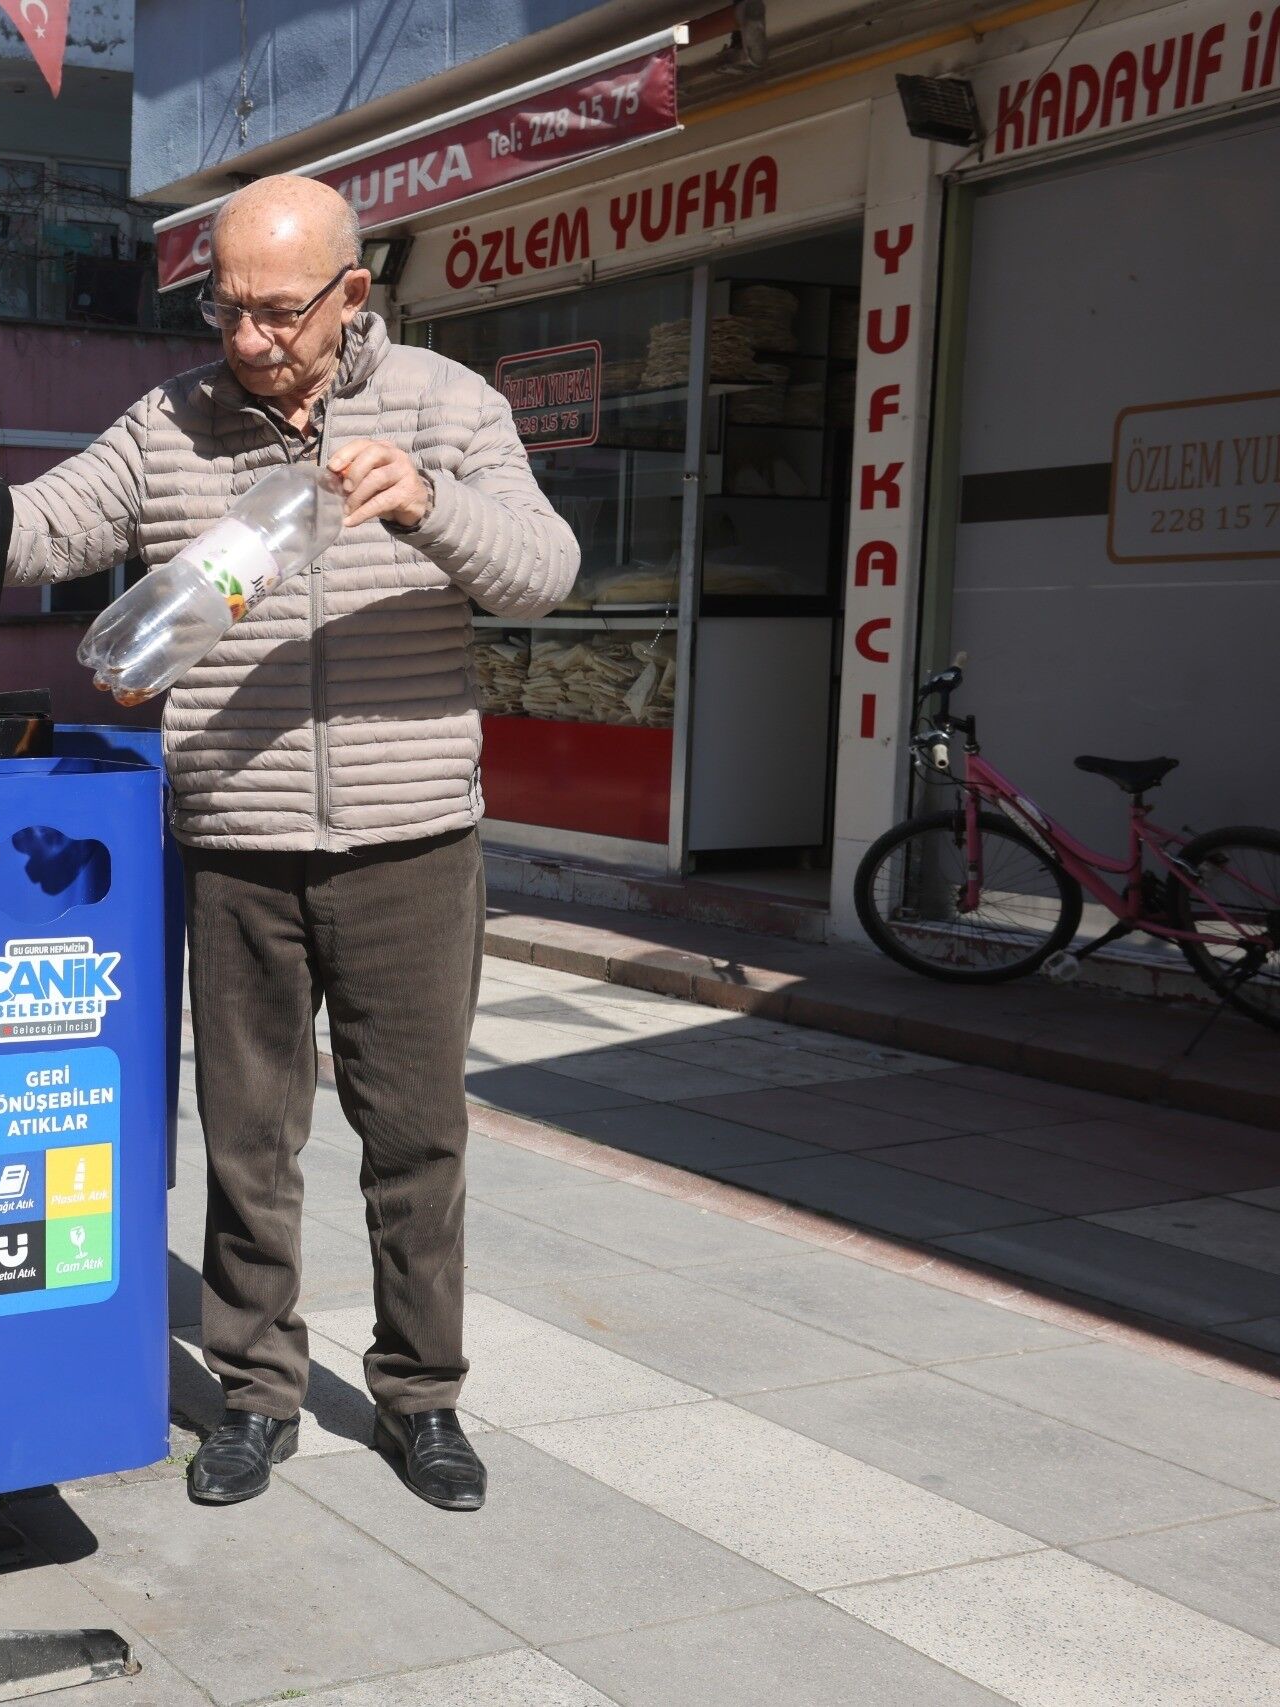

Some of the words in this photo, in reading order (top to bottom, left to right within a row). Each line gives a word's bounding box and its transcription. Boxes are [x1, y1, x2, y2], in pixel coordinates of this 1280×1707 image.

[995, 23, 1225, 154] KADAYIF
[488, 128, 523, 159] Tel:
[529, 108, 568, 147] 228
[579, 94, 603, 131] 15
[611, 82, 640, 120] 75
[446, 207, 589, 290] ÖZLEM
[609, 155, 778, 247] YUFKA
[548, 368, 593, 406] YUFKA
[541, 413, 558, 433] 15
[561, 411, 579, 430] 75
[1126, 437, 1223, 493] ÖZLEM
[854, 224, 913, 739] YUFKACI
[1150, 508, 1204, 533] 228
[1217, 505, 1251, 530] 15
[13, 947, 24, 955] BU
[24, 945, 48, 955] GURUR
[49, 942, 86, 953] HEPİMİZİN
[26, 1065, 70, 1088] GERİ
[7, 1115, 88, 1137] ATIKLAR
[16, 1199, 34, 1209] Atık
[17, 1267, 36, 1278] Atık
[56, 1262, 80, 1273] Cam
[82, 1257, 104, 1269] Atık
